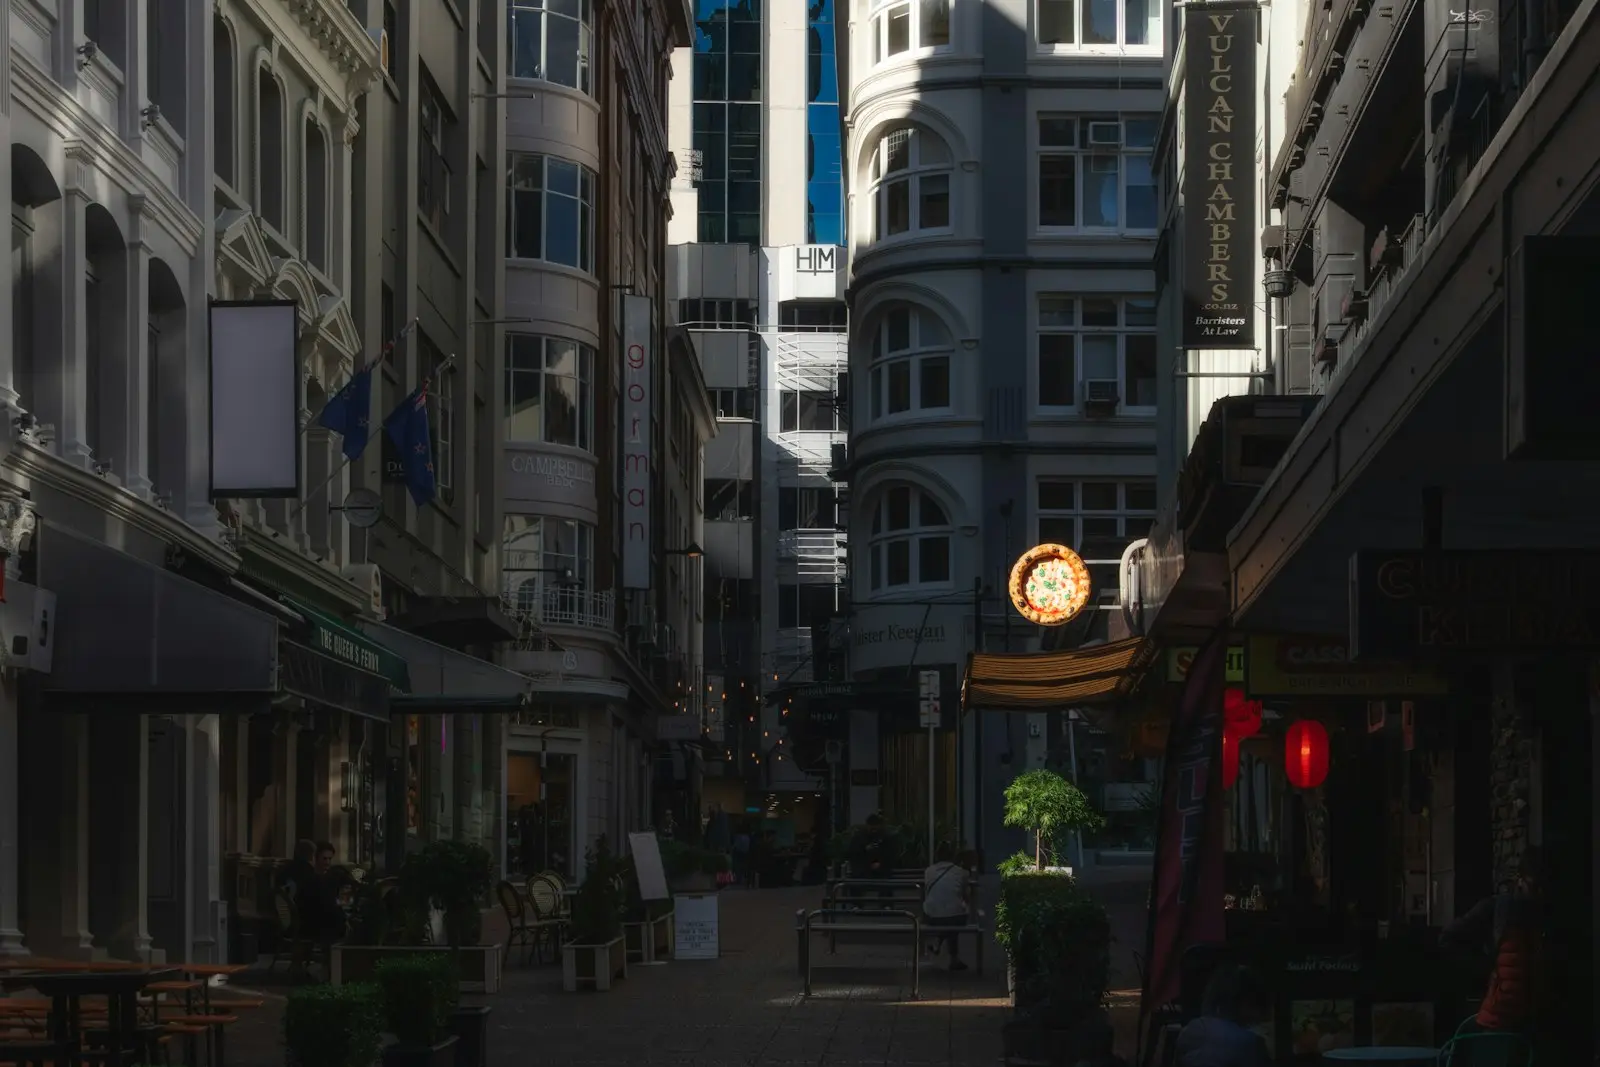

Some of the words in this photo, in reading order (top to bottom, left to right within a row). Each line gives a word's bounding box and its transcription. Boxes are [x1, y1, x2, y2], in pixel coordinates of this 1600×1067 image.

[1207, 14, 1235, 133] VULCAN
[1204, 142, 1237, 302] CHAMBERS
[1195, 316, 1246, 325] Barristers
[1202, 327, 1214, 336] At
[1216, 327, 1239, 336] Law
[625, 344, 648, 541] gorman
[320, 626, 333, 652] THE
